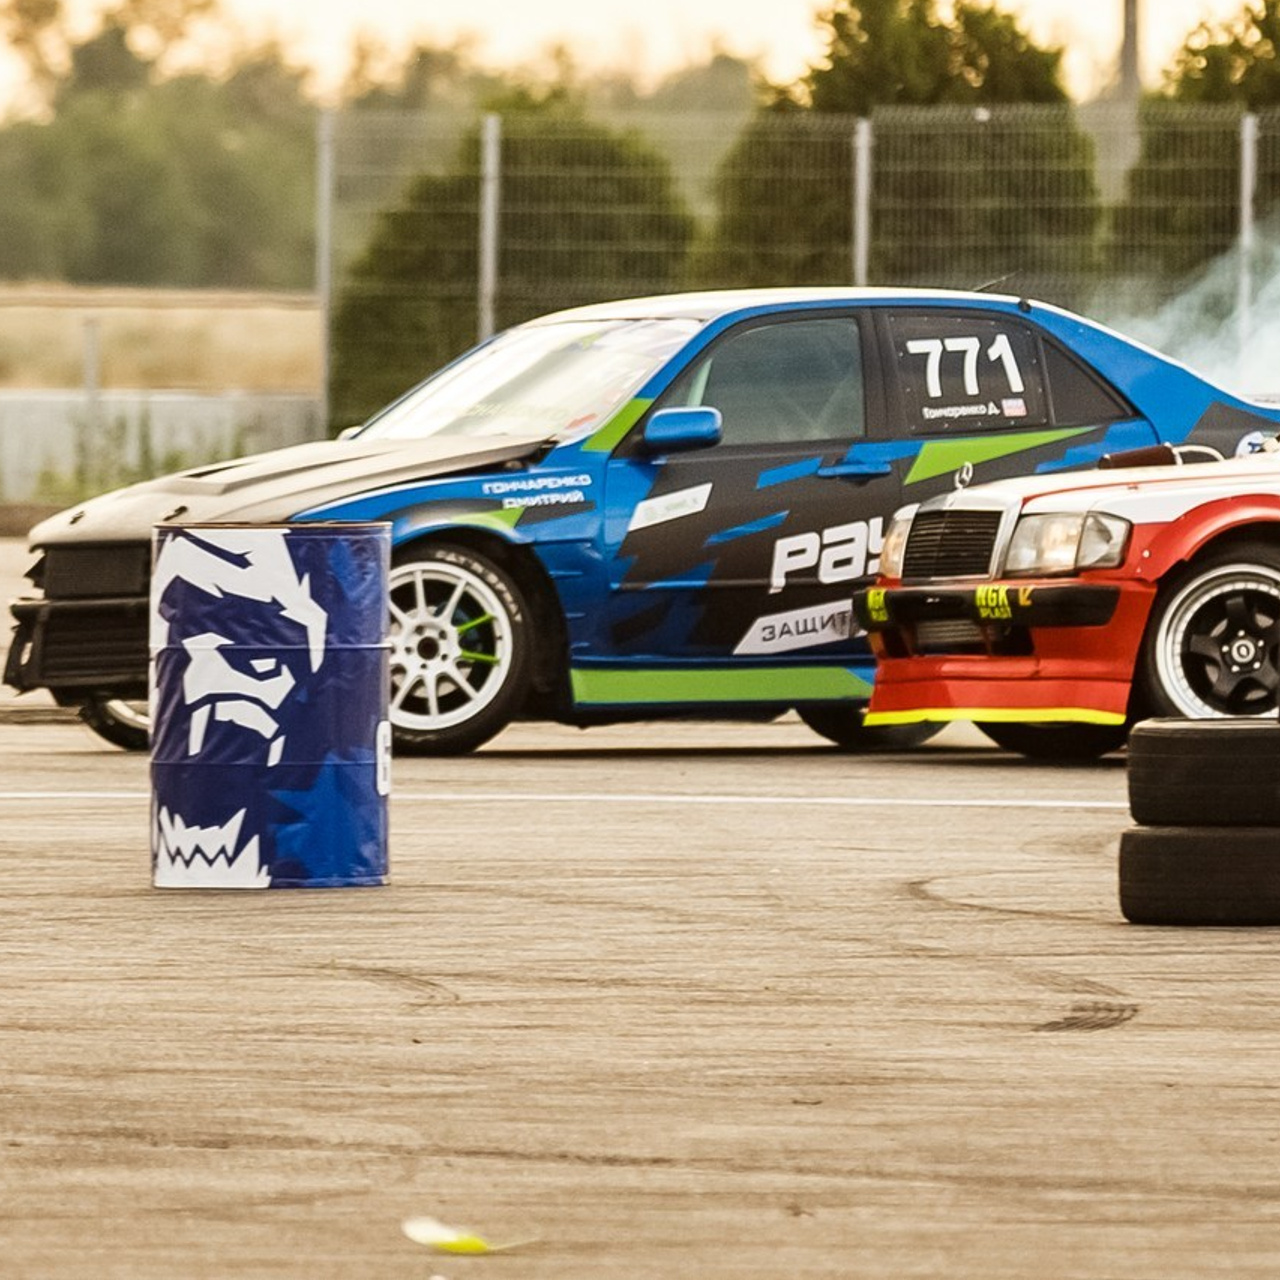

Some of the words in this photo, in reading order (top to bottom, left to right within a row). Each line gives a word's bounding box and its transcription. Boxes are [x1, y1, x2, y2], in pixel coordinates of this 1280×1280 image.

[906, 333, 1025, 398] 771
[482, 474, 592, 494] ГОНЧАРЕНКО
[502, 489, 585, 509] ДМИТРИЙ
